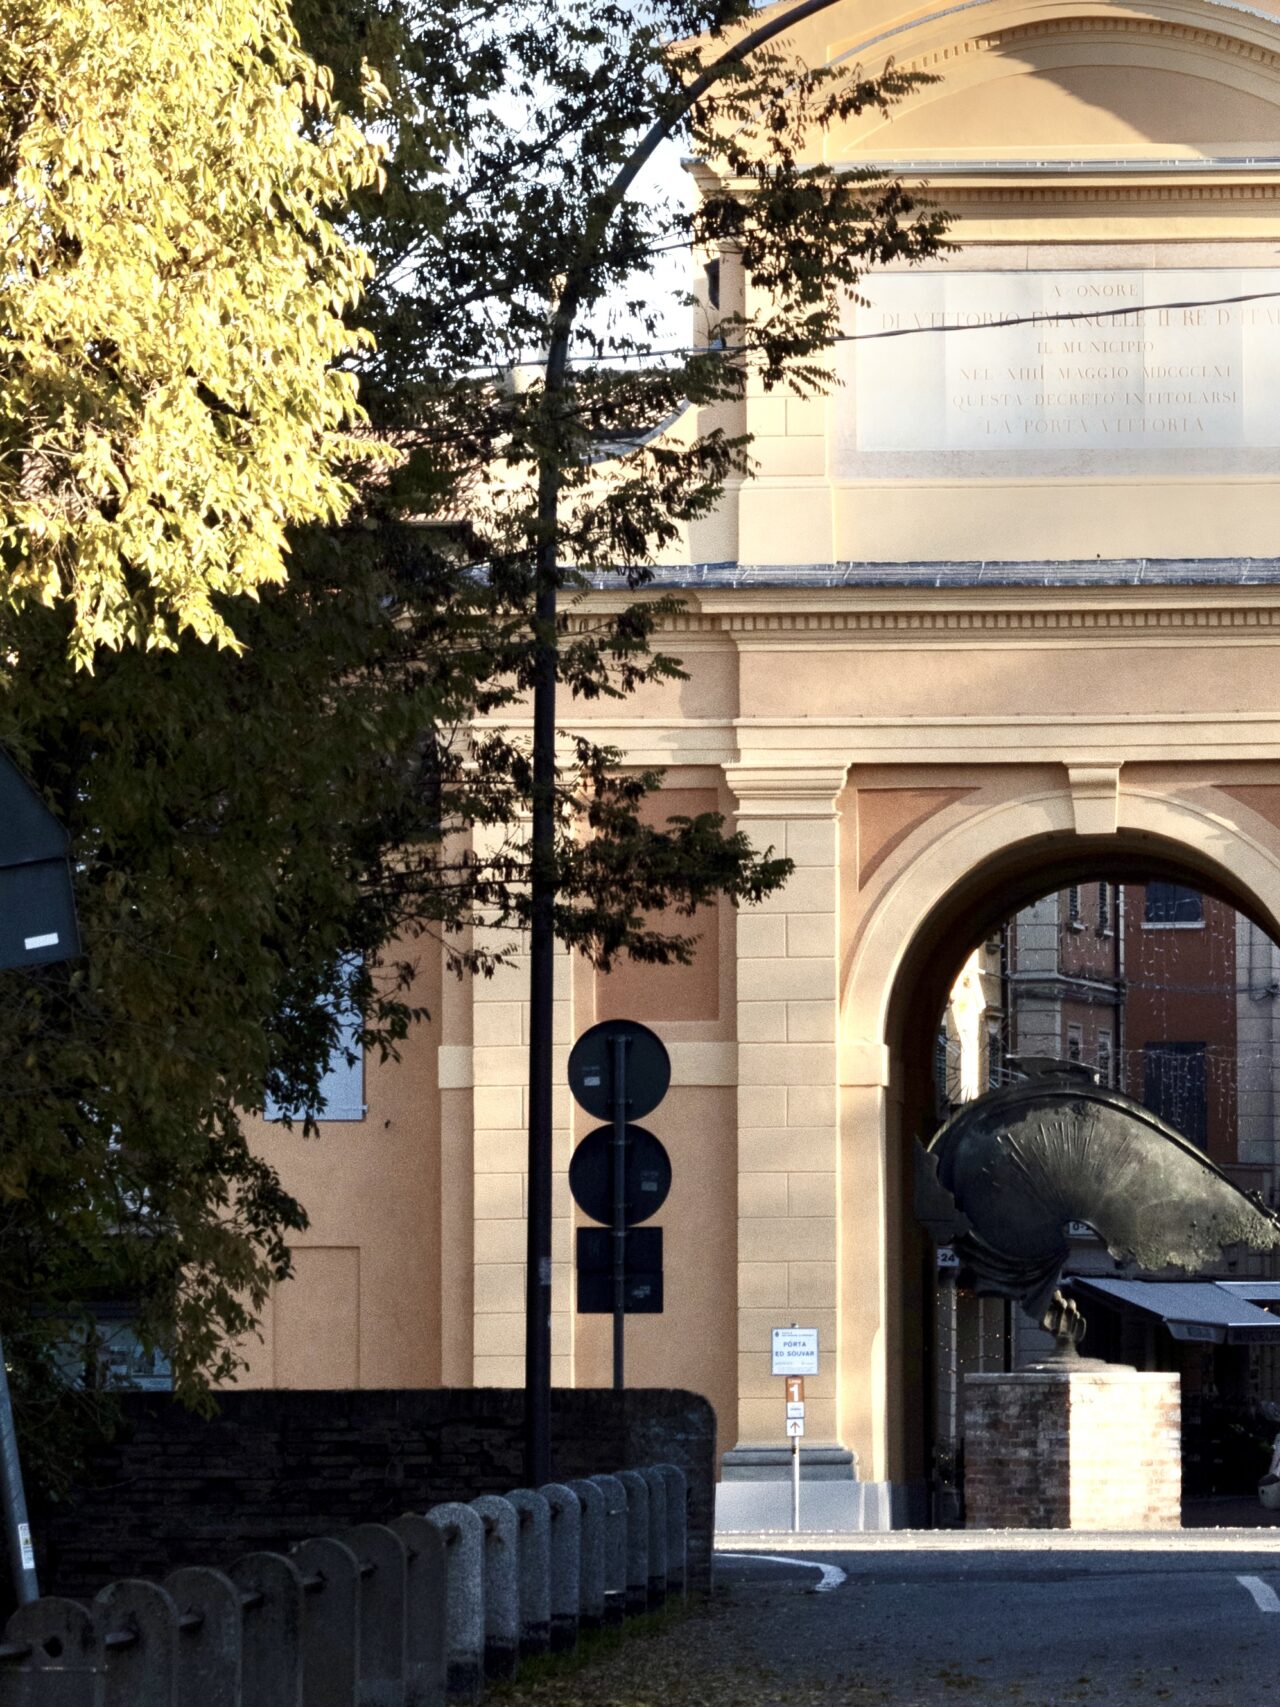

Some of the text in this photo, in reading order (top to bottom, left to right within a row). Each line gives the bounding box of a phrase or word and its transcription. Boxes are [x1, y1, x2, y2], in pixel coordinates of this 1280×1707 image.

[1050, 283, 1139, 298] A ONORE
[881, 311, 901, 330] DI
[912, 311, 1020, 329] VITTORIO
[1032, 309, 1146, 328] EMANUELE
[1182, 308, 1207, 328] RE
[1036, 340, 1155, 355] IL MUNICIPIO
[960, 367, 994, 380] NEL
[1058, 366, 1129, 380] MAGGIO
[1142, 365, 1232, 379] MDCCCLXI
[952, 392, 1024, 411] QUESTA
[1125, 390, 1238, 405] INTITOLARSI
[985, 416, 1205, 435] LA PORTA VITTORIA
[789, 1384, 799, 1402] 1
